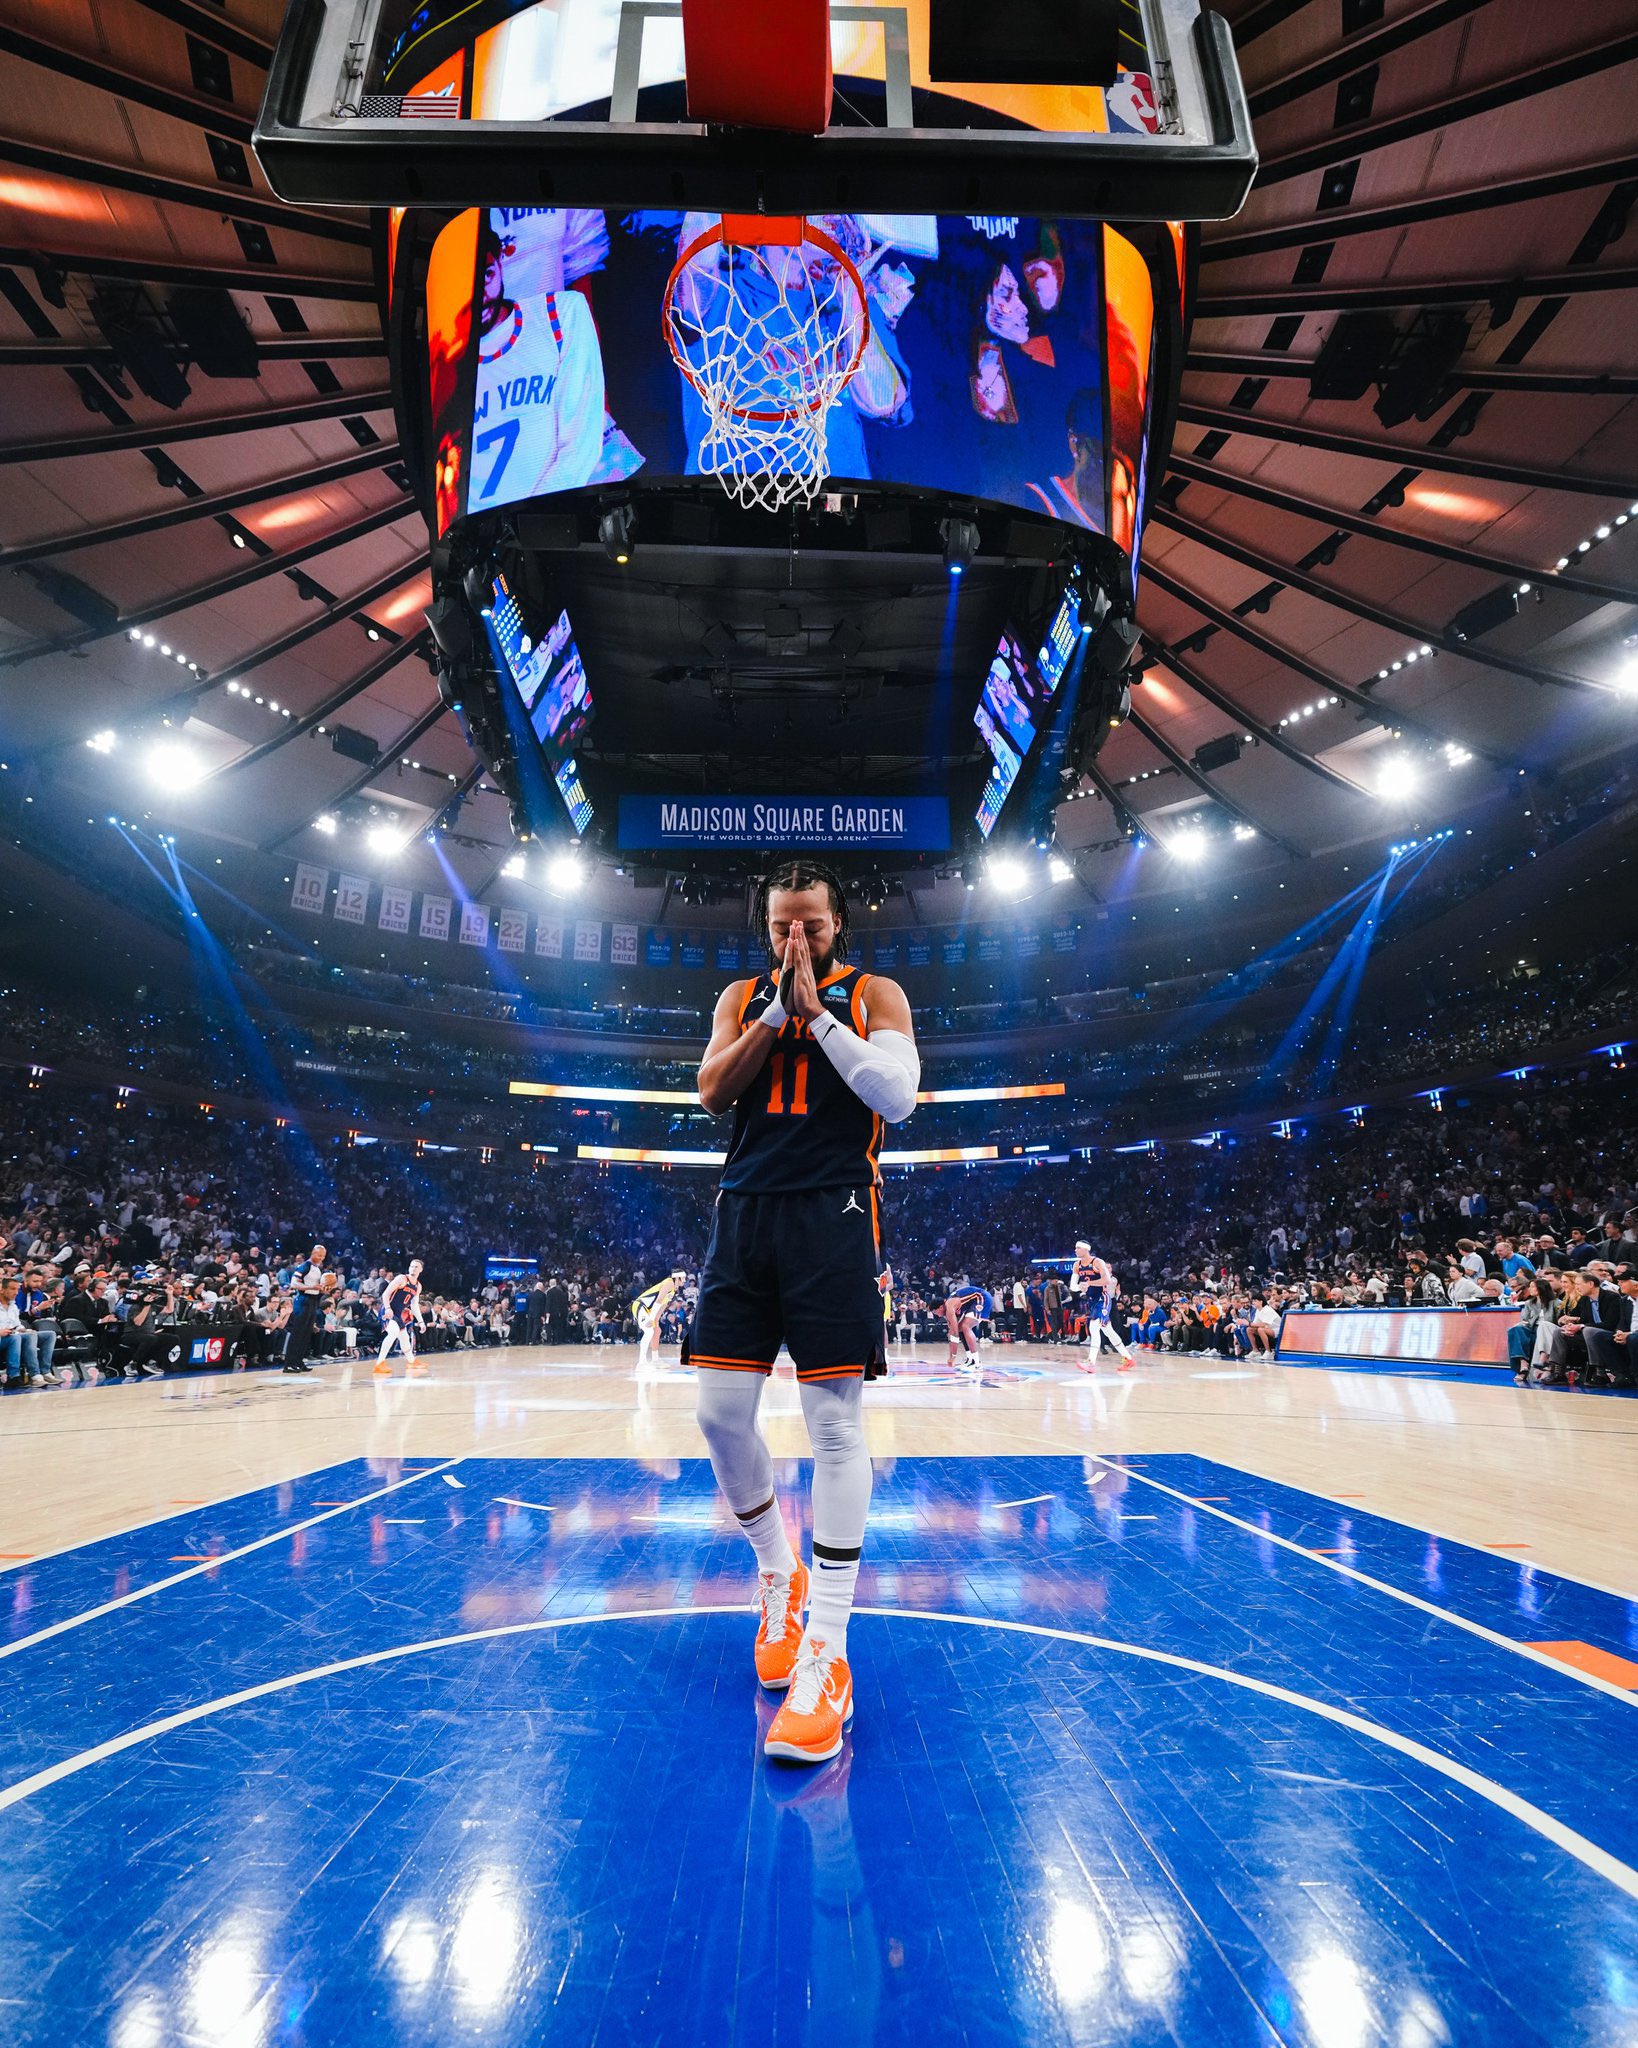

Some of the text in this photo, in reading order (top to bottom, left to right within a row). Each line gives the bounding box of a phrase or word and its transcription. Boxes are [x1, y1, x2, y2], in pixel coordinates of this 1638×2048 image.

[476, 418, 520, 500] 7
[661, 803, 904, 833] MADISON SQUARE GARDEN
[299, 877, 322, 899] 10
[341, 889, 363, 910] 12
[384, 899, 405, 918] 15
[425, 907, 446, 926] 15
[465, 915, 484, 933] 19
[501, 921, 524, 940] 22
[538, 927, 560, 945] 24
[577, 932, 600, 949] 33
[612, 935, 636, 951] 613
[825, 995, 849, 1004] sphere
[313, 1063, 337, 1072] LIGHT
[767, 1052, 809, 1115] 11
[1326, 1314, 1442, 1359] LET'S GO
